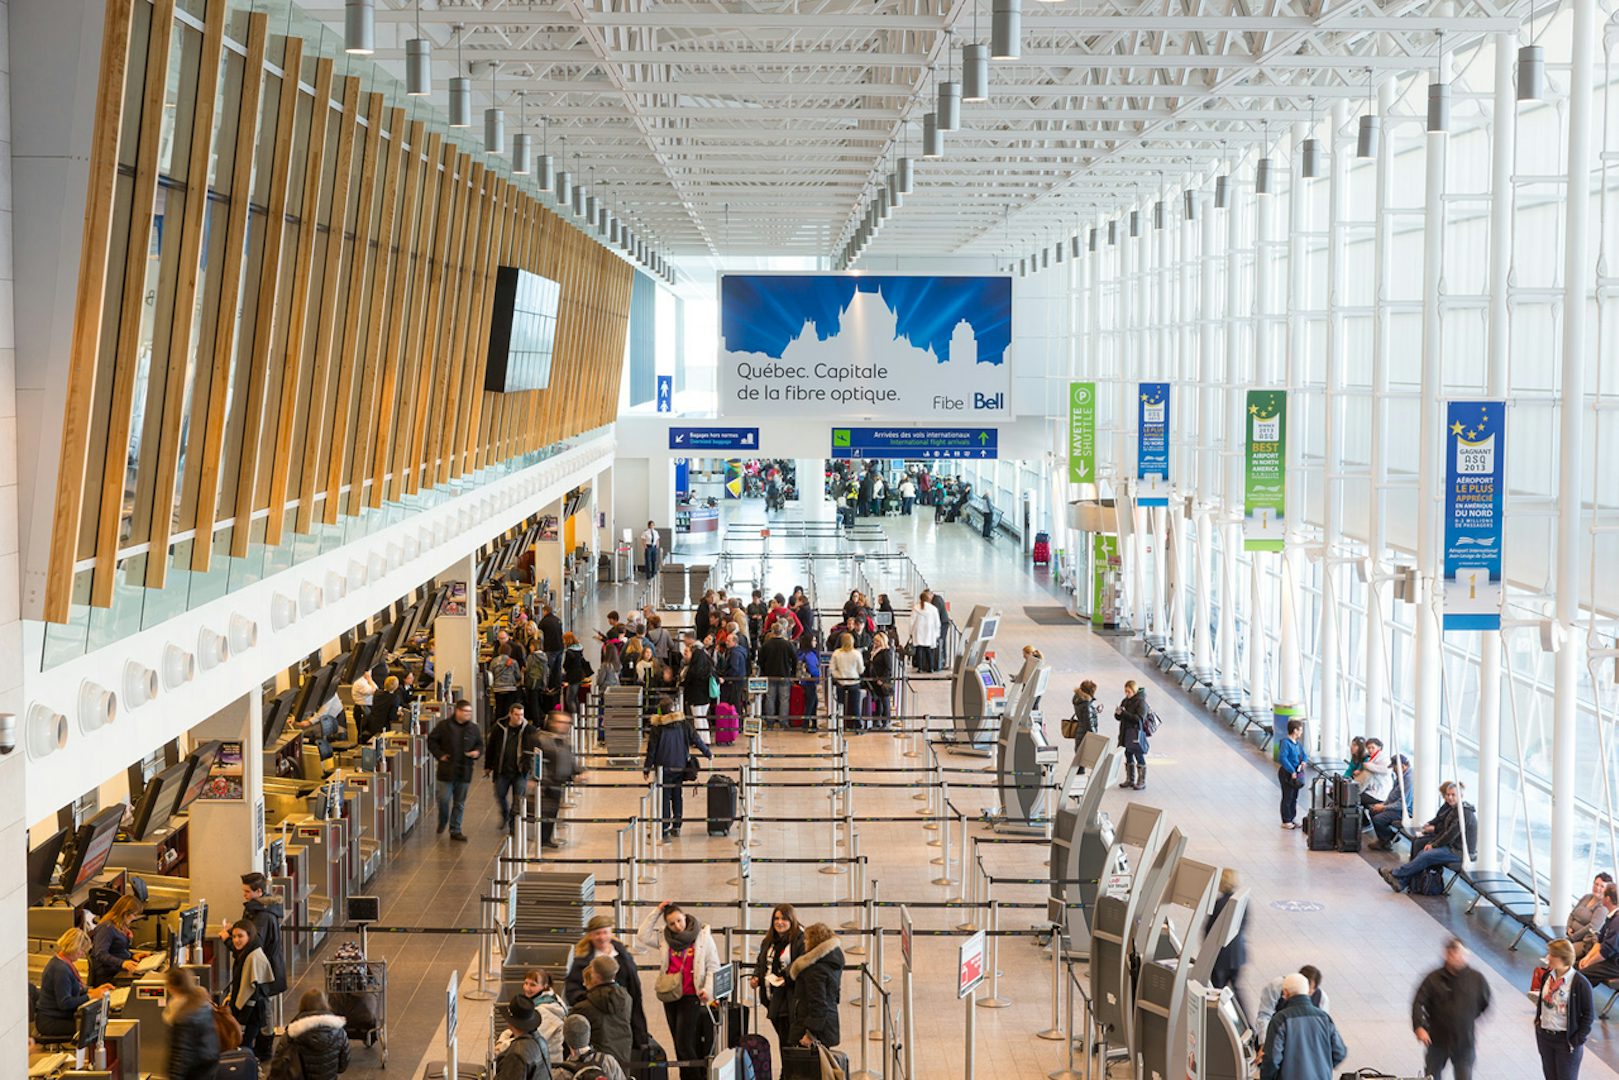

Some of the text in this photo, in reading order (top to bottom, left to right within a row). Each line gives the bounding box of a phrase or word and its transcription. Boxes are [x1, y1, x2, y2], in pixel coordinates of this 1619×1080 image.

[737, 362, 888, 382] Québec. Capitale
[737, 385, 901, 404] de la fibre optique.
[933, 392, 1004, 410] Fibe Bell
[1073, 408, 1082, 456] NAVETTE
[1083, 408, 1092, 456] SHUTTLE
[1252, 442, 1279, 453] BEST
[1465, 455, 1486, 464] ASQ
[1456, 484, 1494, 493] LE PLUS
[1456, 494, 1493, 502] APPRÉCIÉ
[1468, 573, 1476, 599] 1
